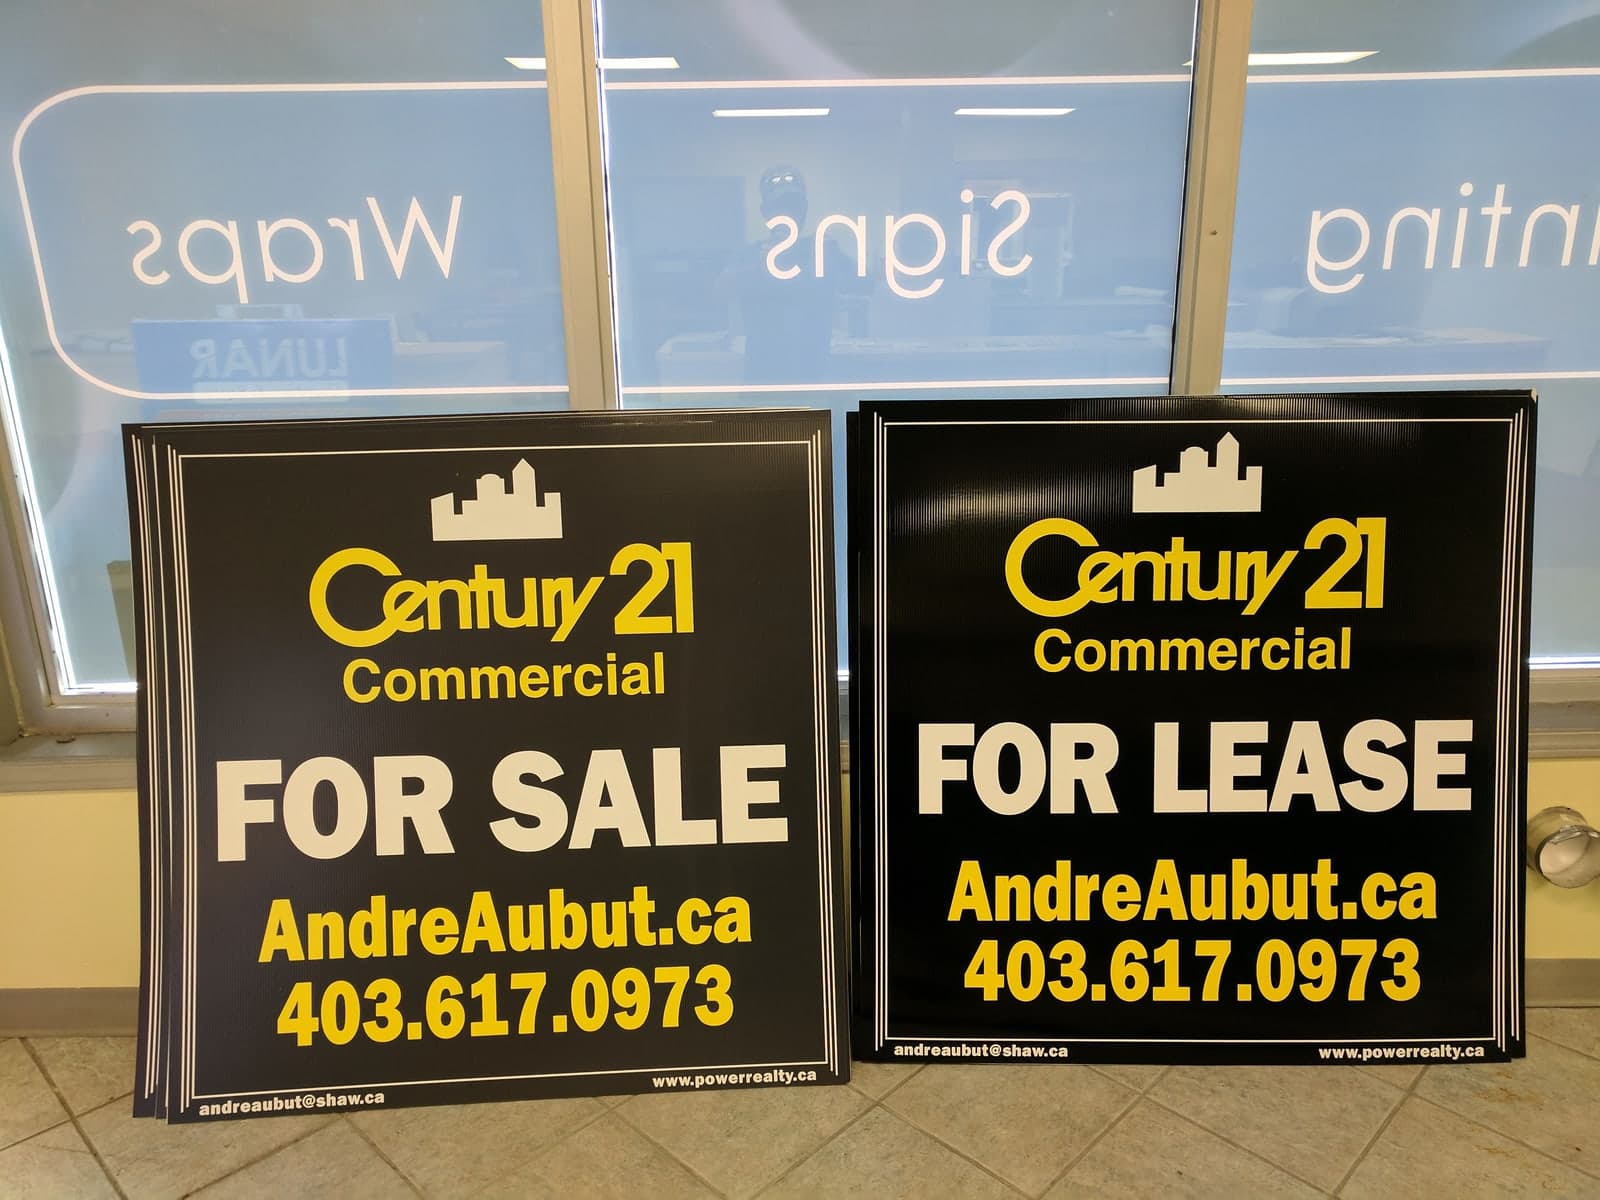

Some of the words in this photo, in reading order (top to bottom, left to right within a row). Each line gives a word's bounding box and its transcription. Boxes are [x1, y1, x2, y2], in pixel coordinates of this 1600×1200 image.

[309, 547, 605, 648] Century
[610, 542, 695, 635] 21
[1005, 518, 1298, 618] Century
[1303, 517, 1387, 609] 21
[343, 652, 665, 704] Commercial
[1034, 627, 1352, 673] Commercial
[918, 722, 1119, 816] FOR
[1153, 719, 1474, 813] LEASE
[216, 755, 455, 862] FOR
[490, 744, 789, 853] SALE
[947, 858, 1437, 922] AndreAubut.ca
[258, 886, 753, 964] AndreAubut.ca
[963, 938, 1421, 1003] 403.617.0973
[276, 963, 734, 1047] 403.617.0973
[652, 1069, 817, 1088] www.powerrealty.ca
[893, 1043, 1069, 1058] andreaubut@shaw.ca
[1318, 1044, 1485, 1062] www.powerrealty.ca
[198, 1091, 386, 1117] andreaubut@shaw.ca
